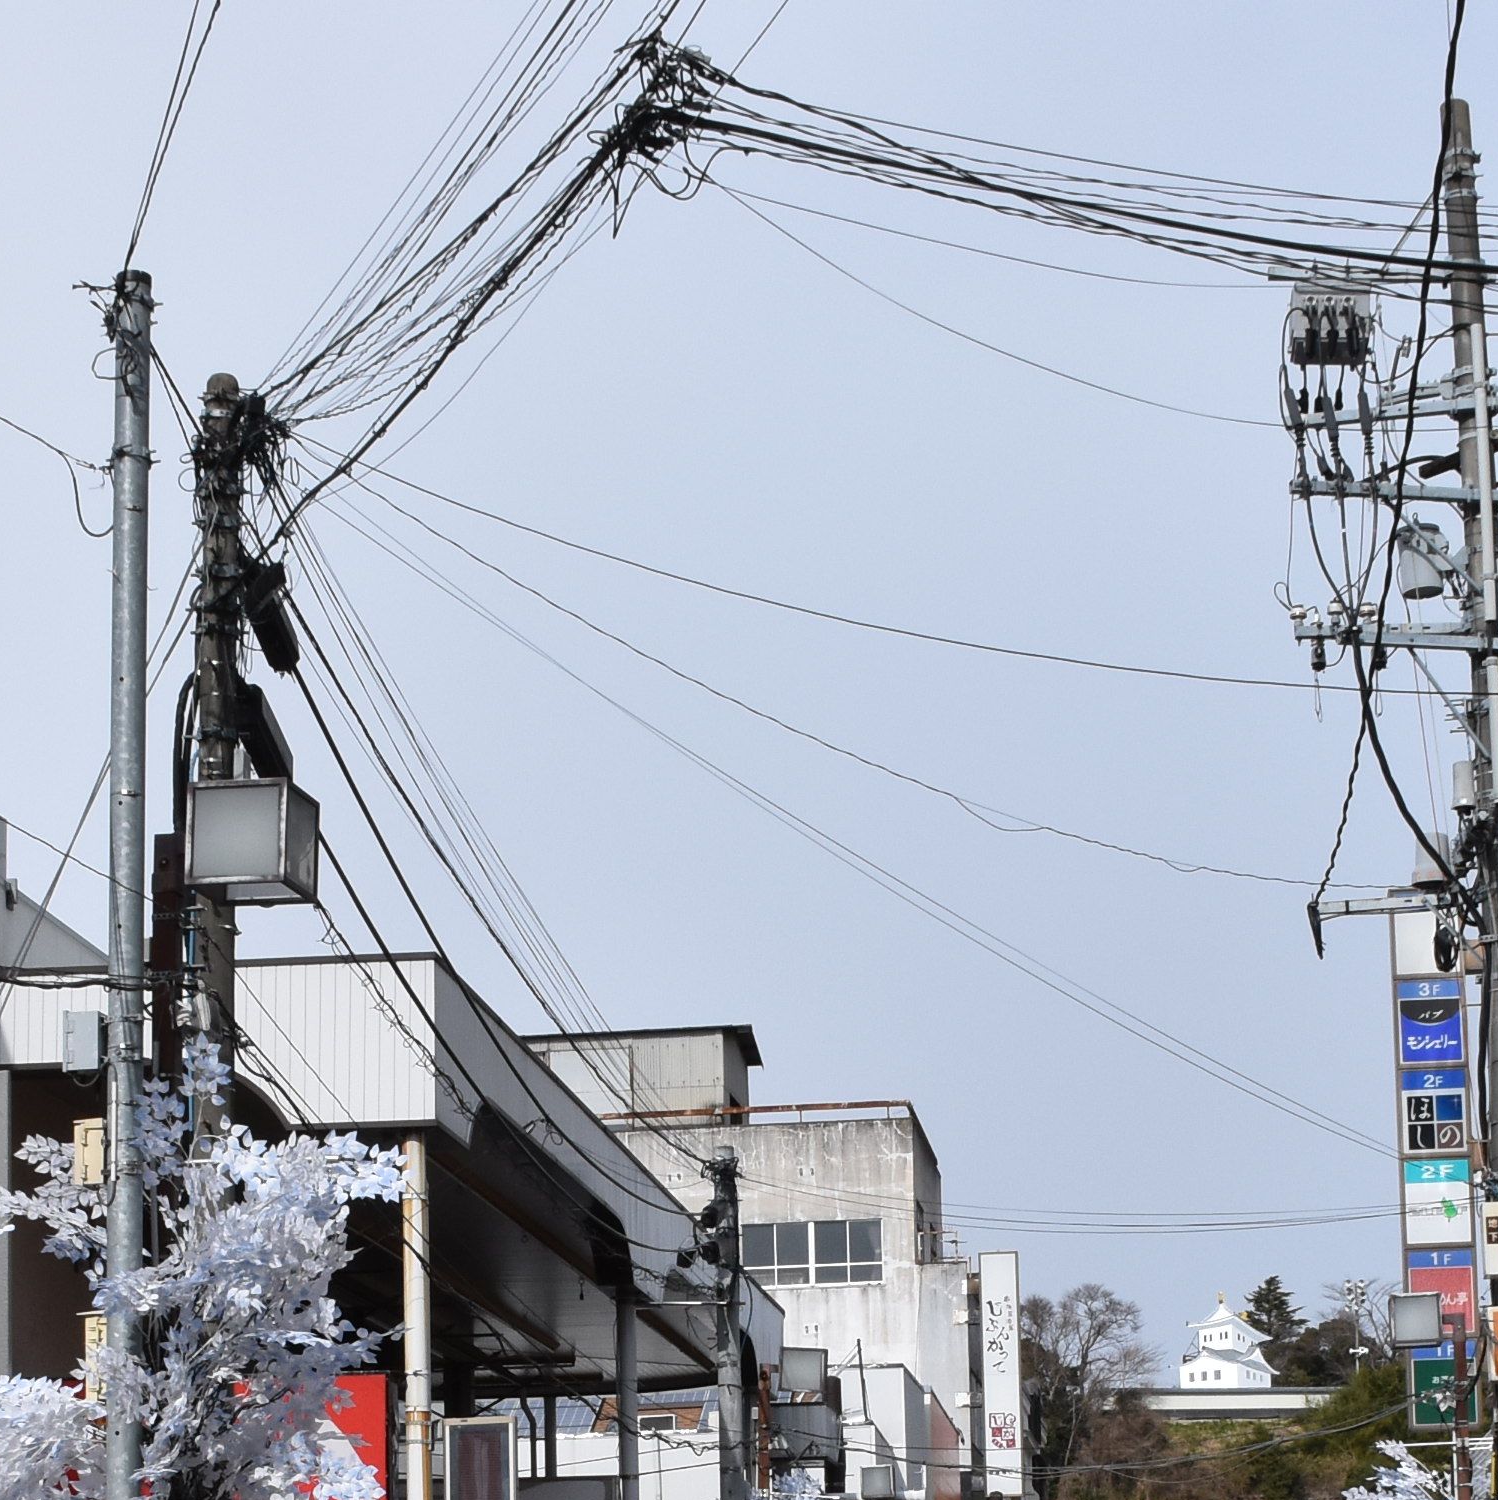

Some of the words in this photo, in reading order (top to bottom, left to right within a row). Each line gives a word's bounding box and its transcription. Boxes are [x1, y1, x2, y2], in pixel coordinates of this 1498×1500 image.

[1423, 1074, 1444, 1088] 2F
[1420, 1164, 1454, 1179] 2F
[1430, 1252, 1453, 1266] 1F
